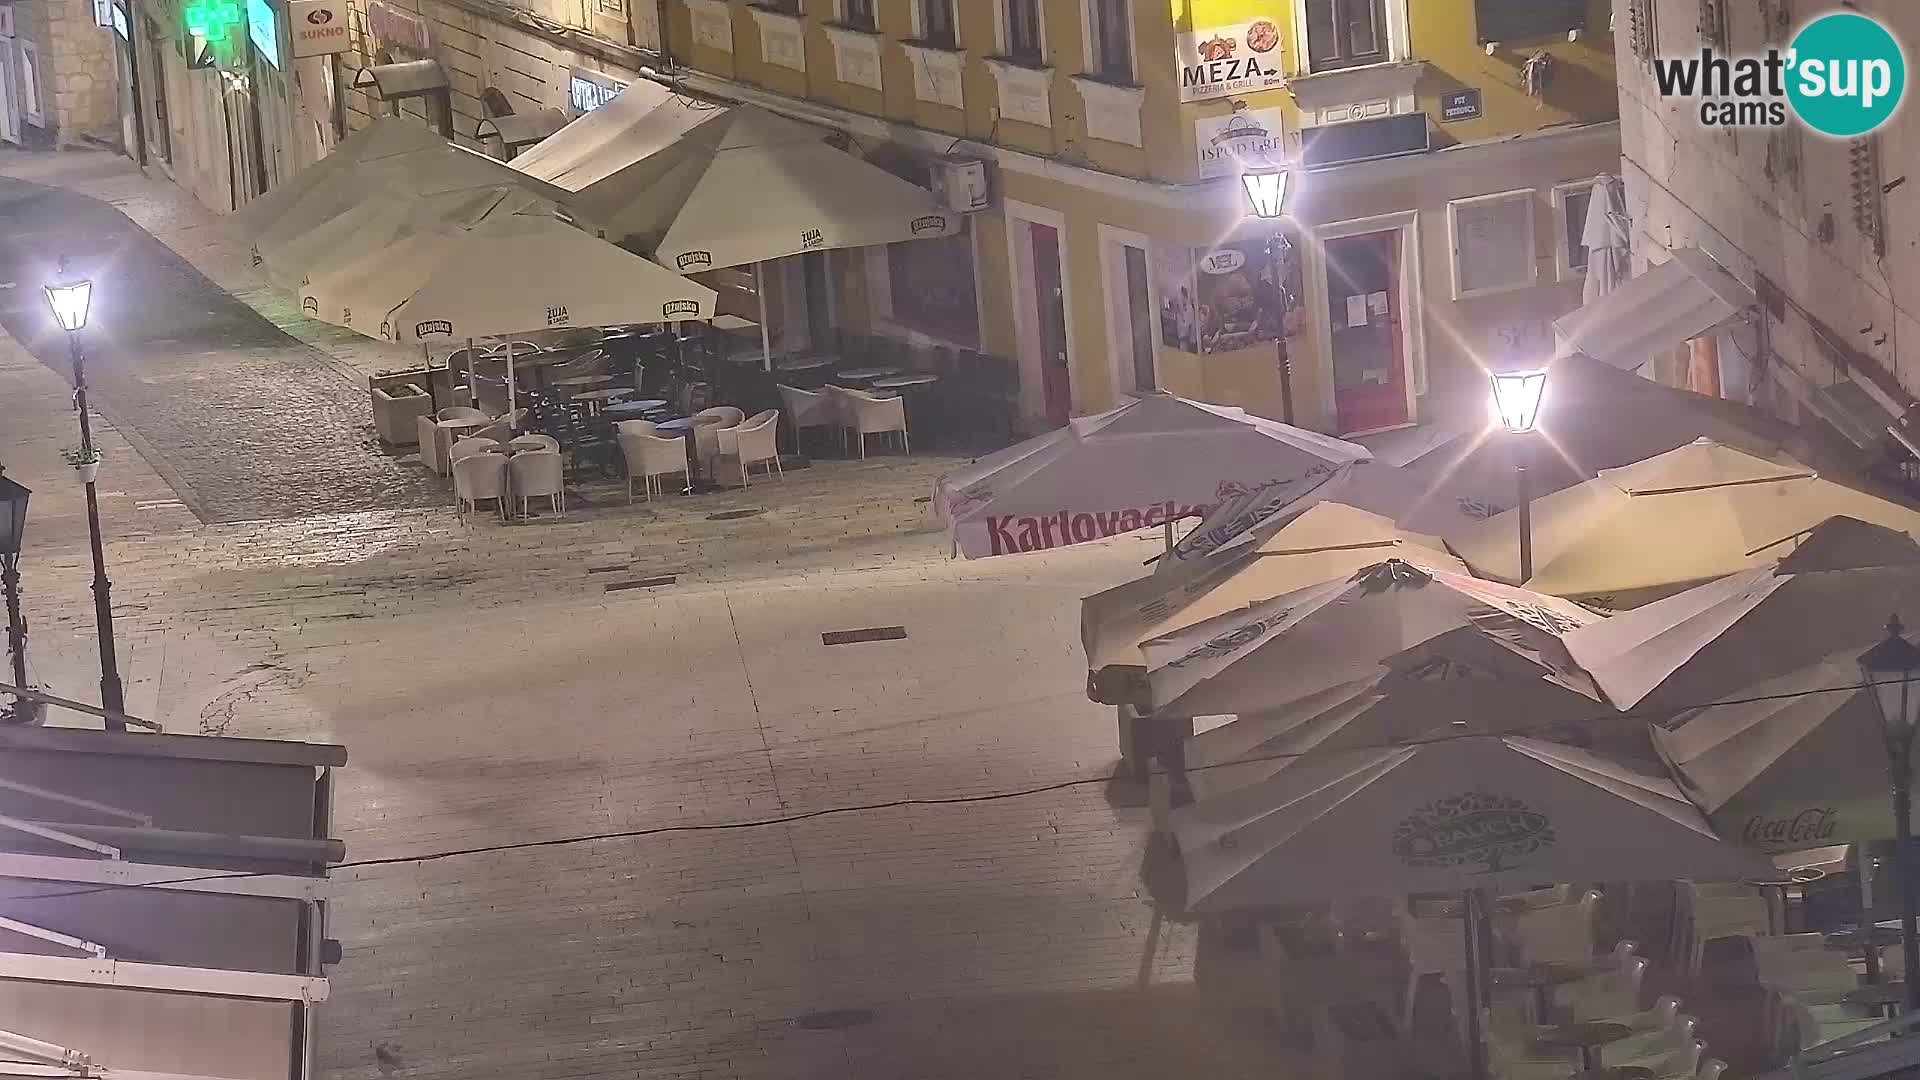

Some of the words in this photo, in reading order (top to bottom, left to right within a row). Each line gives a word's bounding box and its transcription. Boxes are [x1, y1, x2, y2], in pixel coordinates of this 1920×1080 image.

[302, 27, 344, 39] SUKNO
[1183, 57, 1262, 87] MEZA
[1192, 84, 1224, 96] PIZZERIA
[1233, 79, 1254, 89] GRILL
[1202, 143, 1247, 161] ISPOD
[547, 306, 568, 319] ŽUJA
[665, 301, 697, 314] Ožujsko
